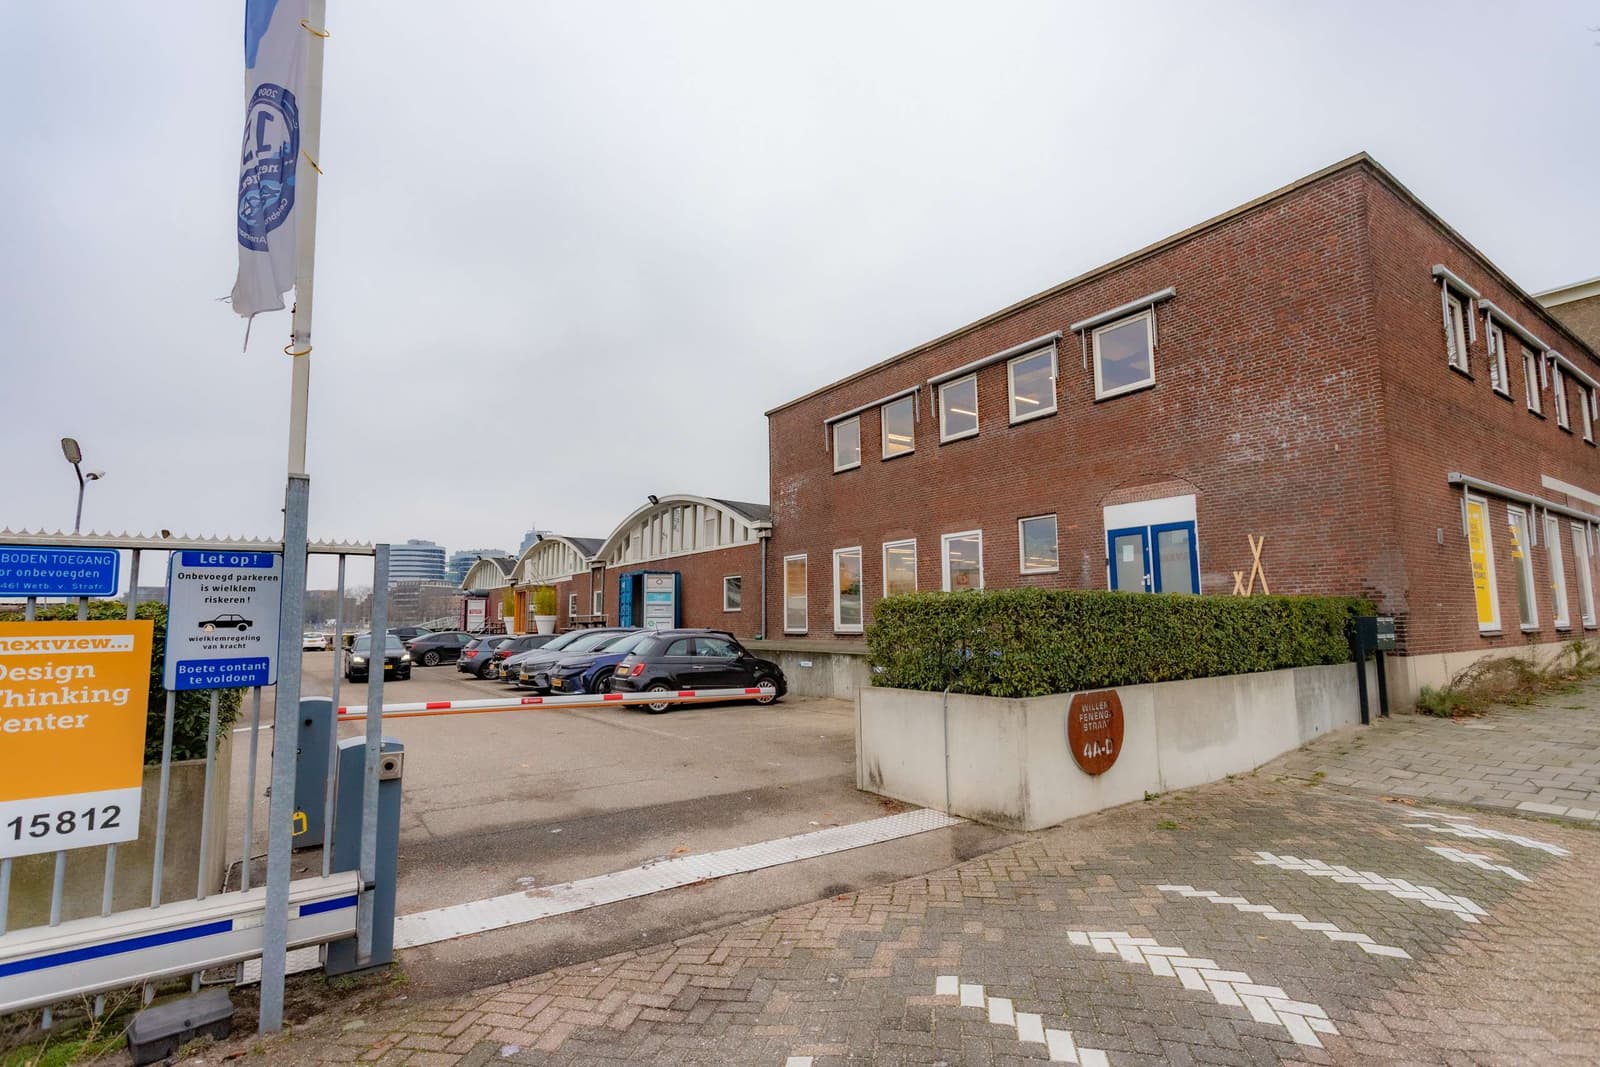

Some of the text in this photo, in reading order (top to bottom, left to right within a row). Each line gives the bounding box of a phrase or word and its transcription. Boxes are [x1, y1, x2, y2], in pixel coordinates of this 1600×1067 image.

[0, 553, 111, 565] BODEN TOEGANG
[200, 553, 225, 564] Let
[0, 568, 100, 580] or onbevoegden
[177, 572, 279, 582] Onbevoegd parkeren
[200, 583, 256, 592] is wielklem
[188, 634, 261, 642] wielklemregeling
[178, 662, 267, 674] Boete contant
[189, 674, 256, 685] te voldoen
[0, 686, 131, 708] hinking
[0, 713, 89, 733] enter
[7, 805, 121, 841] 15812
